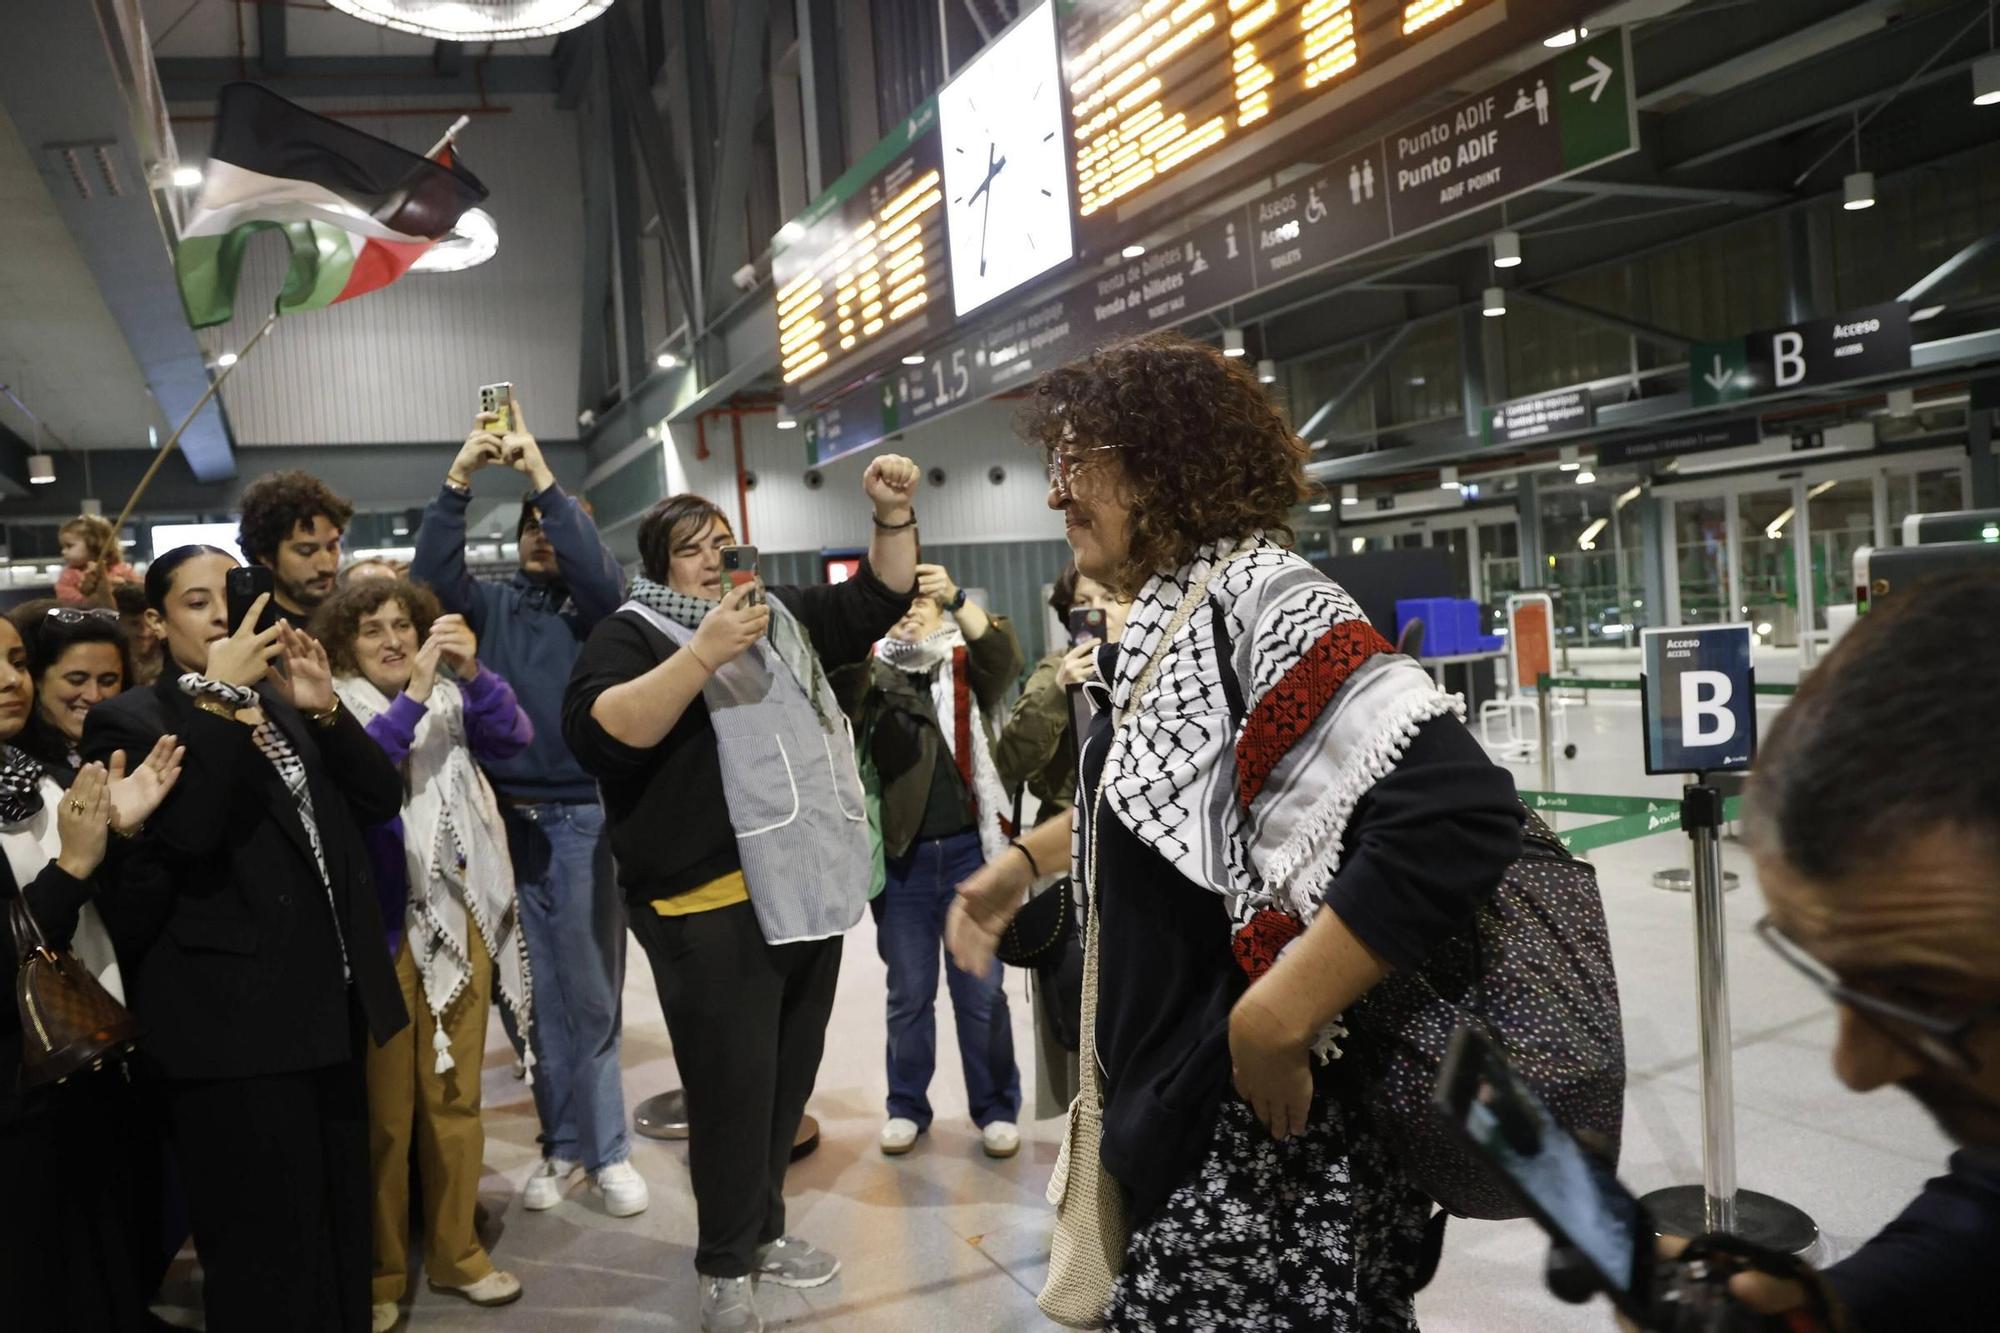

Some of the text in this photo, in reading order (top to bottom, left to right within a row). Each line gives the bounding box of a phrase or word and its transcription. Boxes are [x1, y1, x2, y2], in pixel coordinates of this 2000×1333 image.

[1398, 96, 1495, 159] Punto ADIF
[1398, 130, 1498, 192] Punto ADIF
[1440, 166, 1501, 204] ADIF POINT
[1259, 193, 1297, 223] Aseos
[1260, 220, 1300, 249] Aseos
[1127, 289, 1141, 308] de
[1143, 271, 1184, 301] billetes
[1833, 318, 1880, 340] Acceso
[1773, 331, 1806, 388] B
[1667, 639, 1700, 649] Acceso
[1667, 650, 1691, 658] ACCESS
[1680, 670, 1736, 747] B
